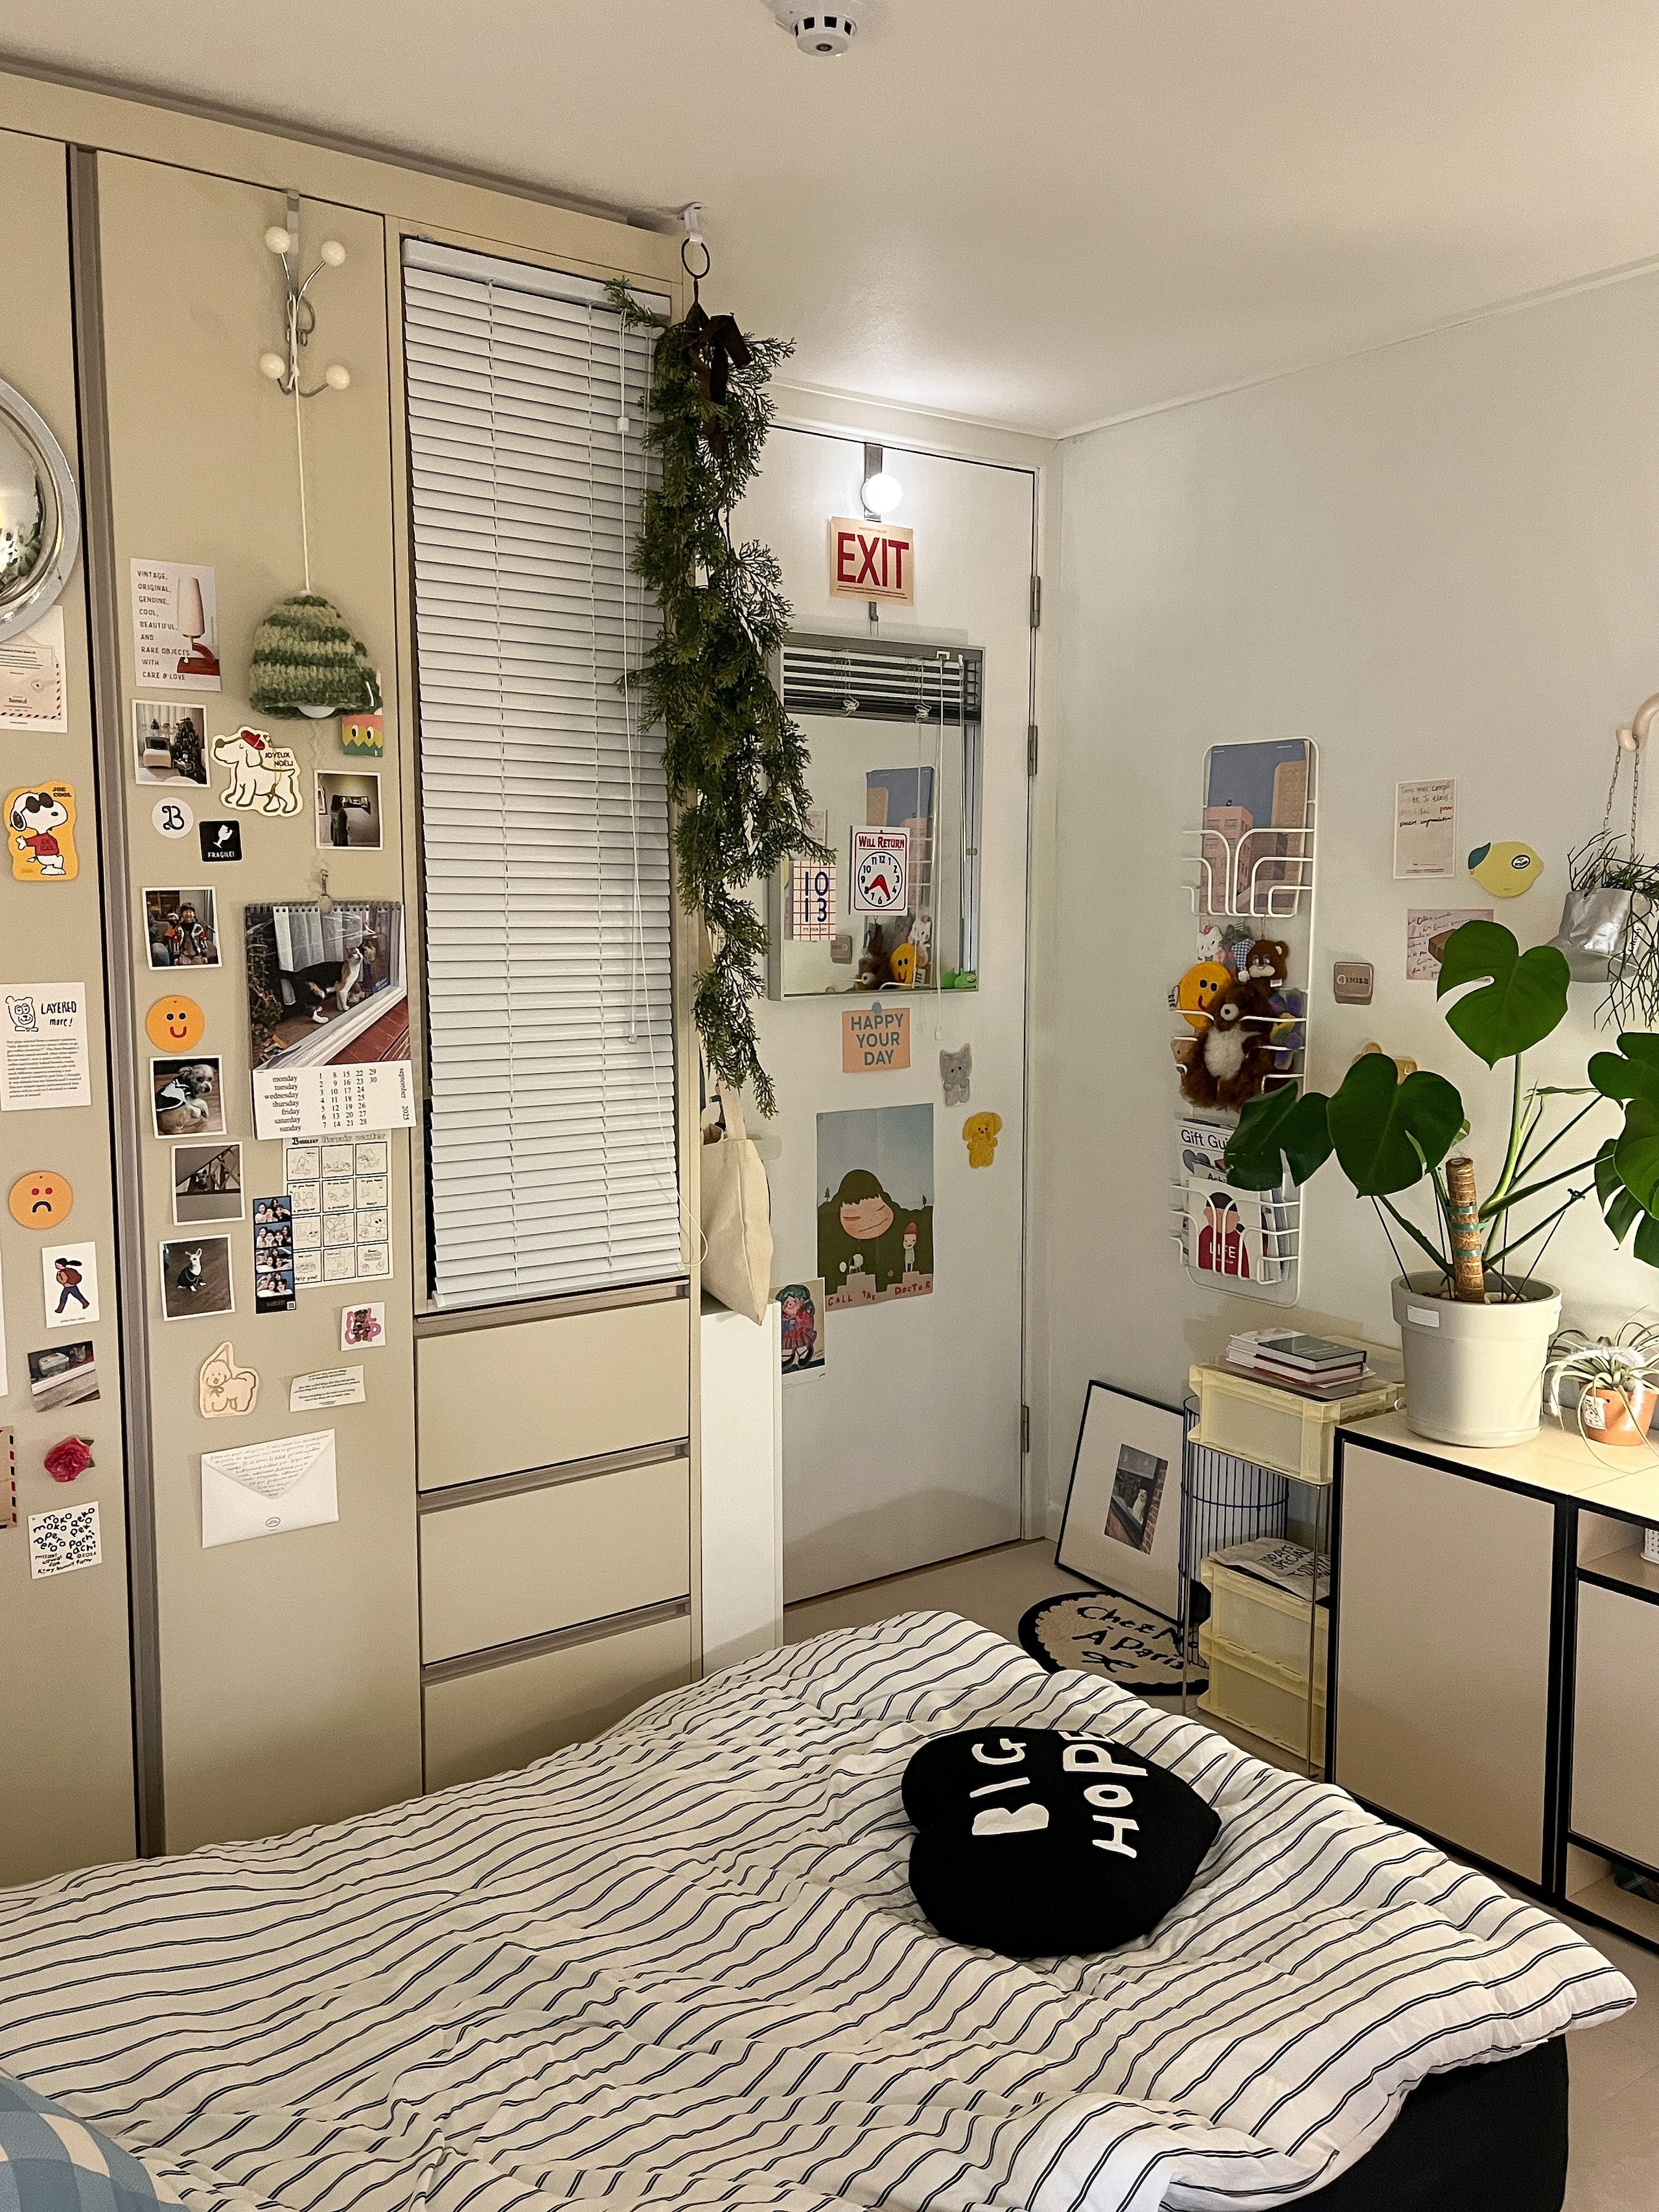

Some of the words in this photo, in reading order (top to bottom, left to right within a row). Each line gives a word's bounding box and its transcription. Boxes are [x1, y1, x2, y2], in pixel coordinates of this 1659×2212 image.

[837, 531, 909, 589] EXIT
[137, 570, 168, 580] VINTAGE,
[138, 583, 171, 593] ORIGINAL,
[139, 596, 169, 605] GENUINE,
[140, 621, 178, 631] BEAUTIFUL,
[161, 805, 185, 830] B
[859, 836, 876, 847] WILL
[877, 836, 905, 848] RETURN
[806, 871, 830, 896] 10
[864, 886, 869, 894] 8
[892, 885, 896, 894] 4
[806, 898, 827, 922] 13
[41, 1001, 77, 1014] LAYERED
[851, 1014, 903, 1030] HAPPY
[856, 1032, 899, 1048] YOUR
[864, 1050, 894, 1065] DAY
[1181, 1129, 1204, 1147] Gift
[828, 1295, 852, 1306] CALL
[863, 1291, 875, 1301] THE
[895, 1281, 931, 1296] DOCTOR
[43, 1513, 72, 1523] moko
[33, 1523, 67, 1533] moko
[33, 1537, 57, 1552] pero
[45, 1532, 66, 1547] pero
[969, 1738, 1049, 1835] BIG
[1058, 1730, 1148, 1858] HOPE
